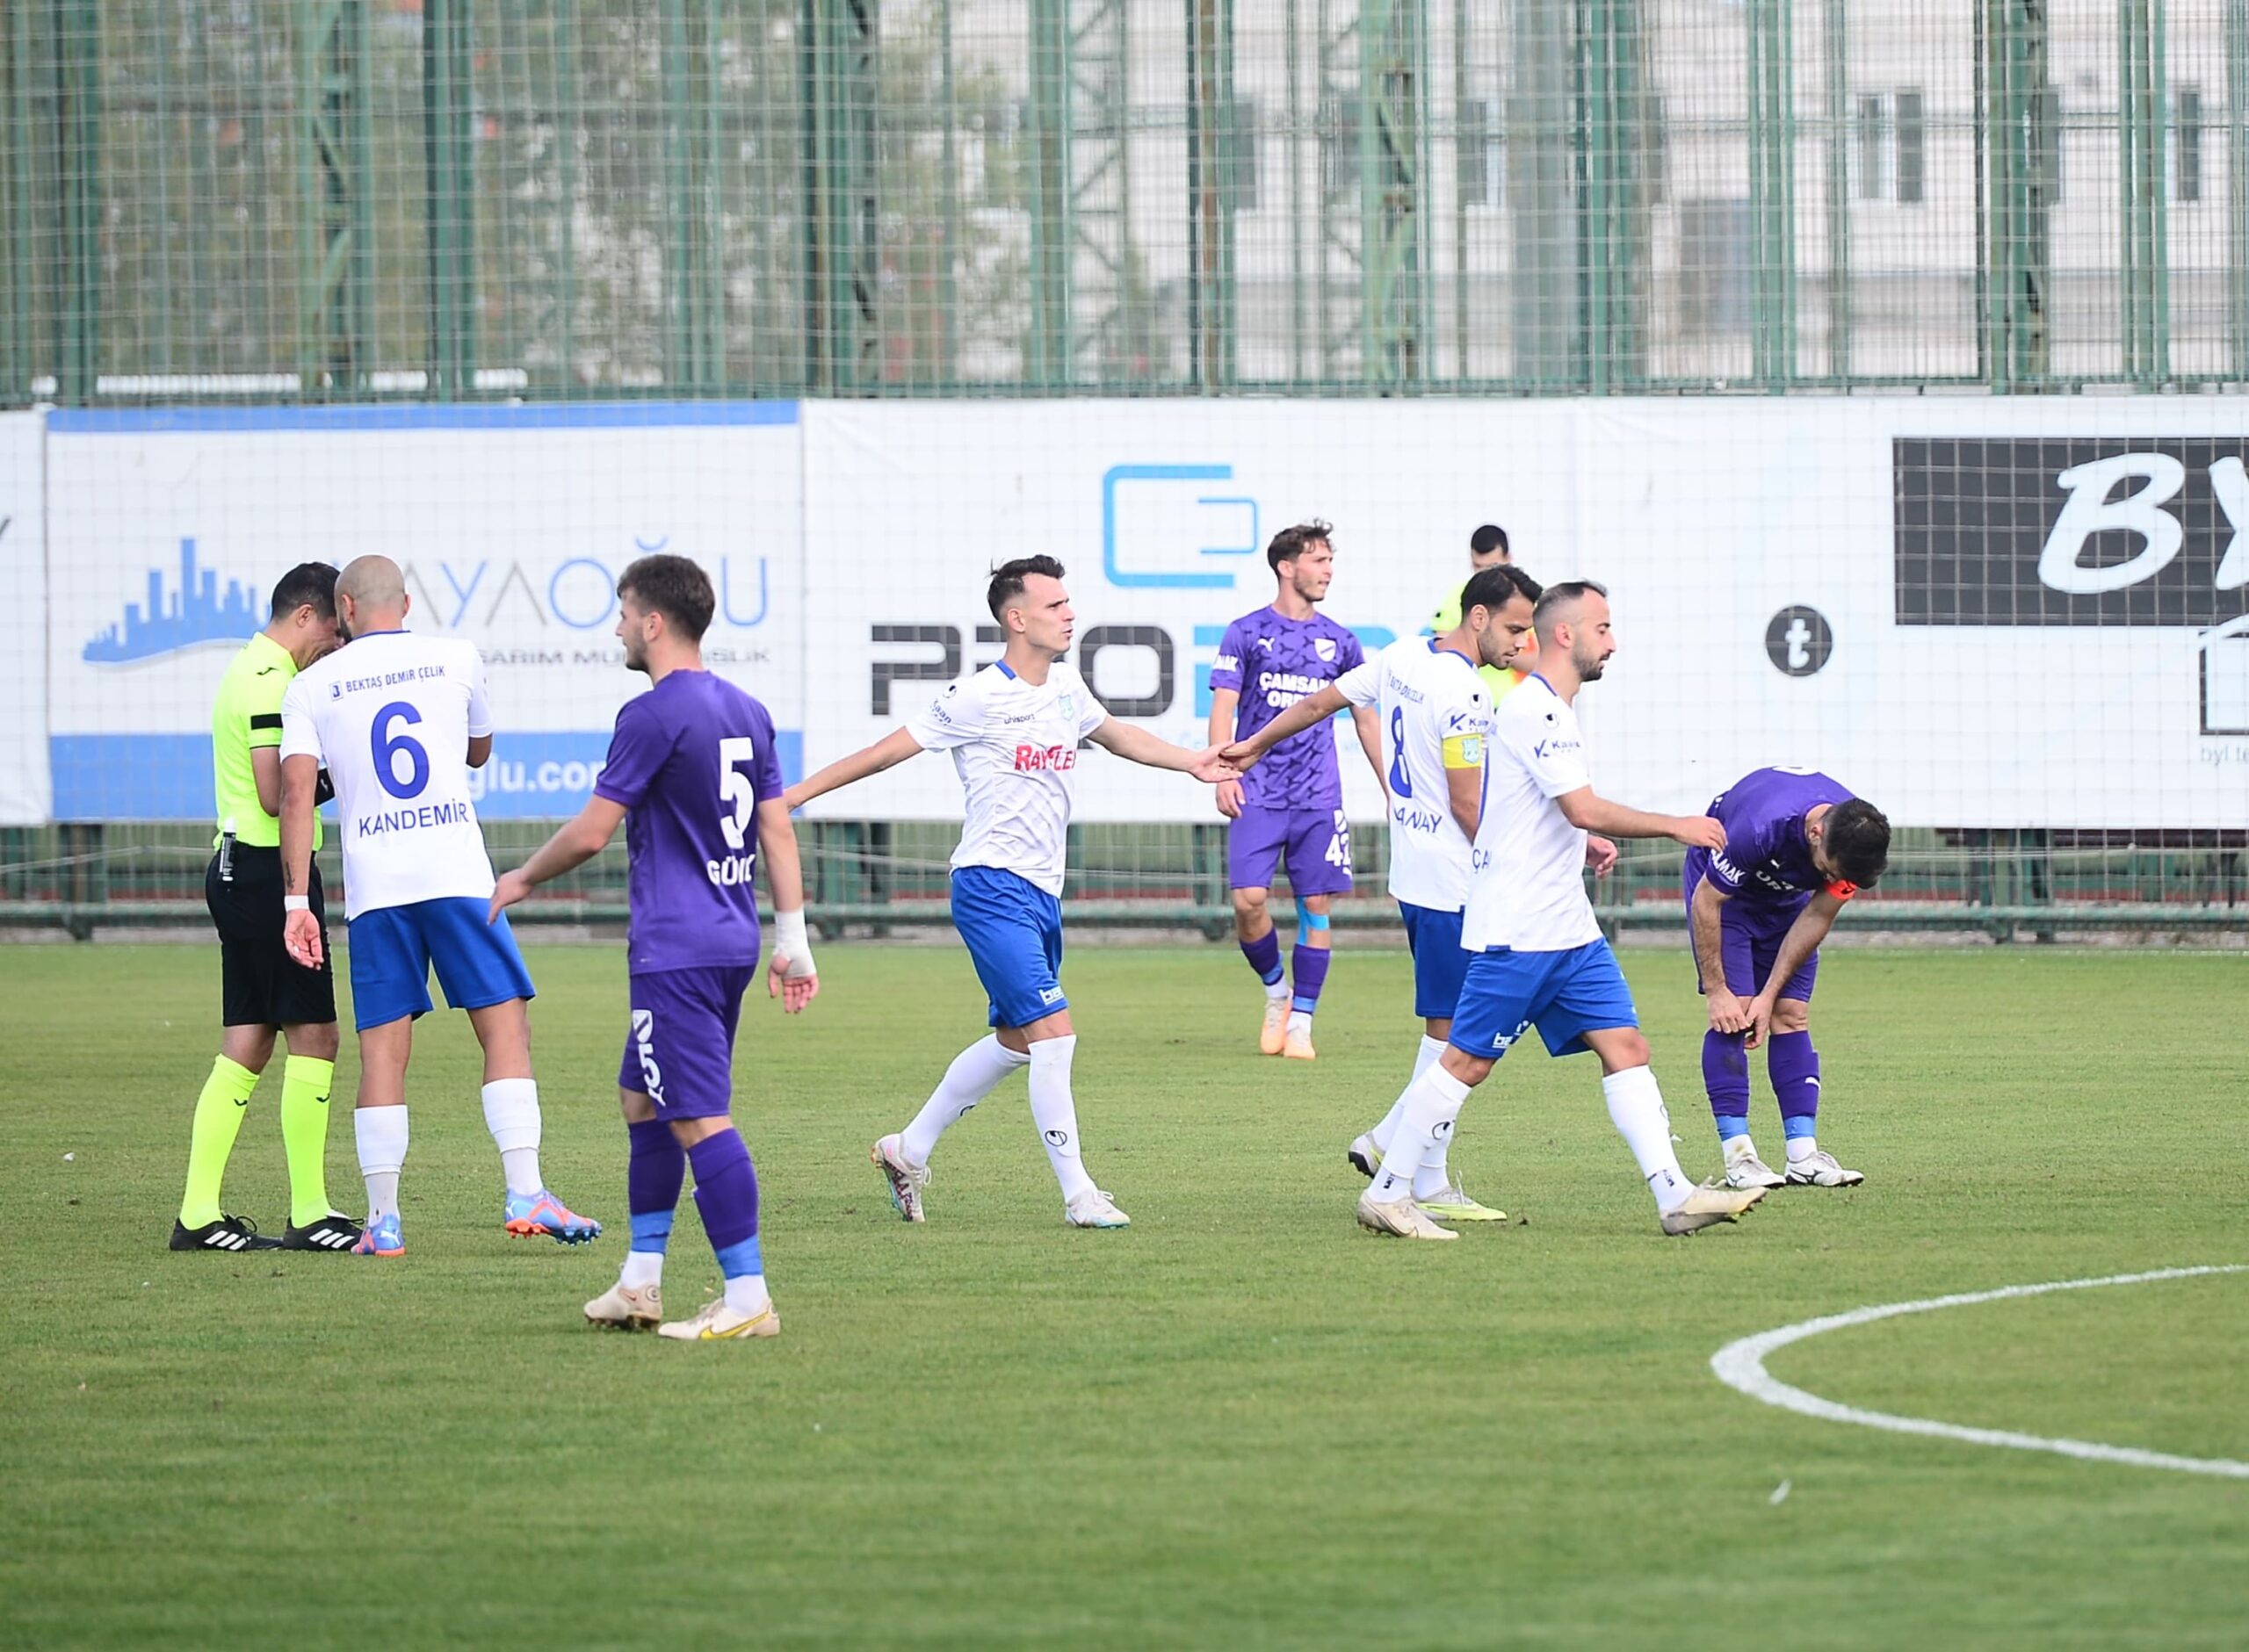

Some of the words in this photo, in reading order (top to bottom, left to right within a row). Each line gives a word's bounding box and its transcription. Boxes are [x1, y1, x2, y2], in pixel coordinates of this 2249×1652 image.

[345, 675, 383, 693] BEKTAŞ
[370, 701, 430, 800] 6
[719, 736, 755, 849] 5
[638, 1043, 661, 1088] 5
